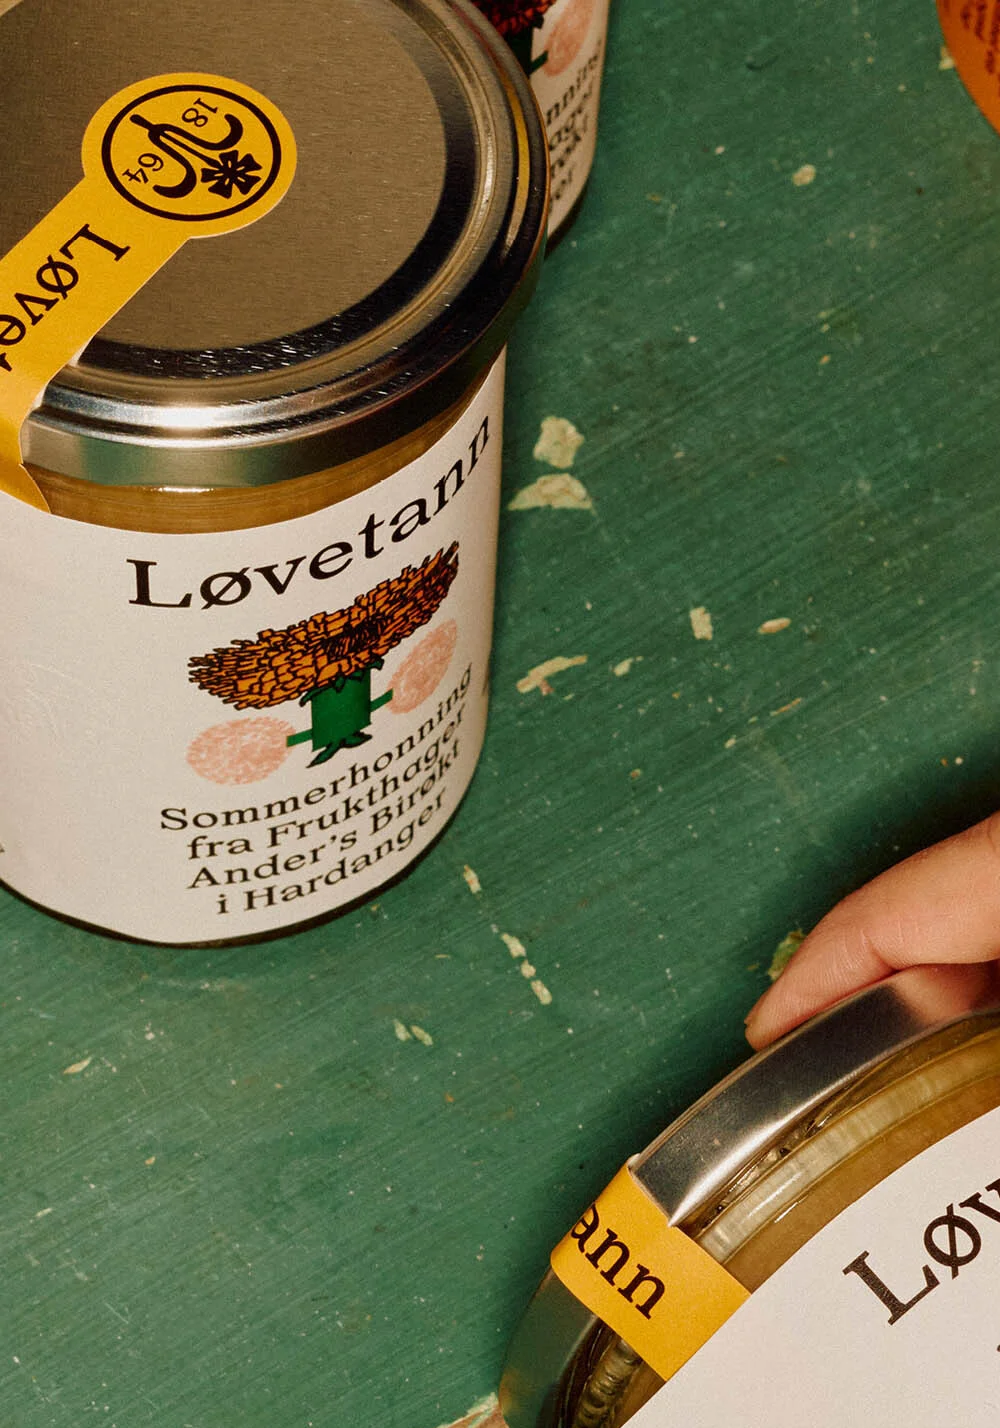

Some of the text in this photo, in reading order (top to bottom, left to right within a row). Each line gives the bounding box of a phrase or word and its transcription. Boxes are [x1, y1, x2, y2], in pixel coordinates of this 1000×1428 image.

[122, 153, 164, 184] 64
[182, 98, 218, 127] 18
[0, 224, 131, 371] Løve
[126, 416, 489, 610] Løvetann
[160, 662, 472, 831] Sommerhonning
[186, 704, 465, 861] fra Frukthager
[186, 830, 356, 889] Ander's
[217, 787, 446, 914] i Hardanger
